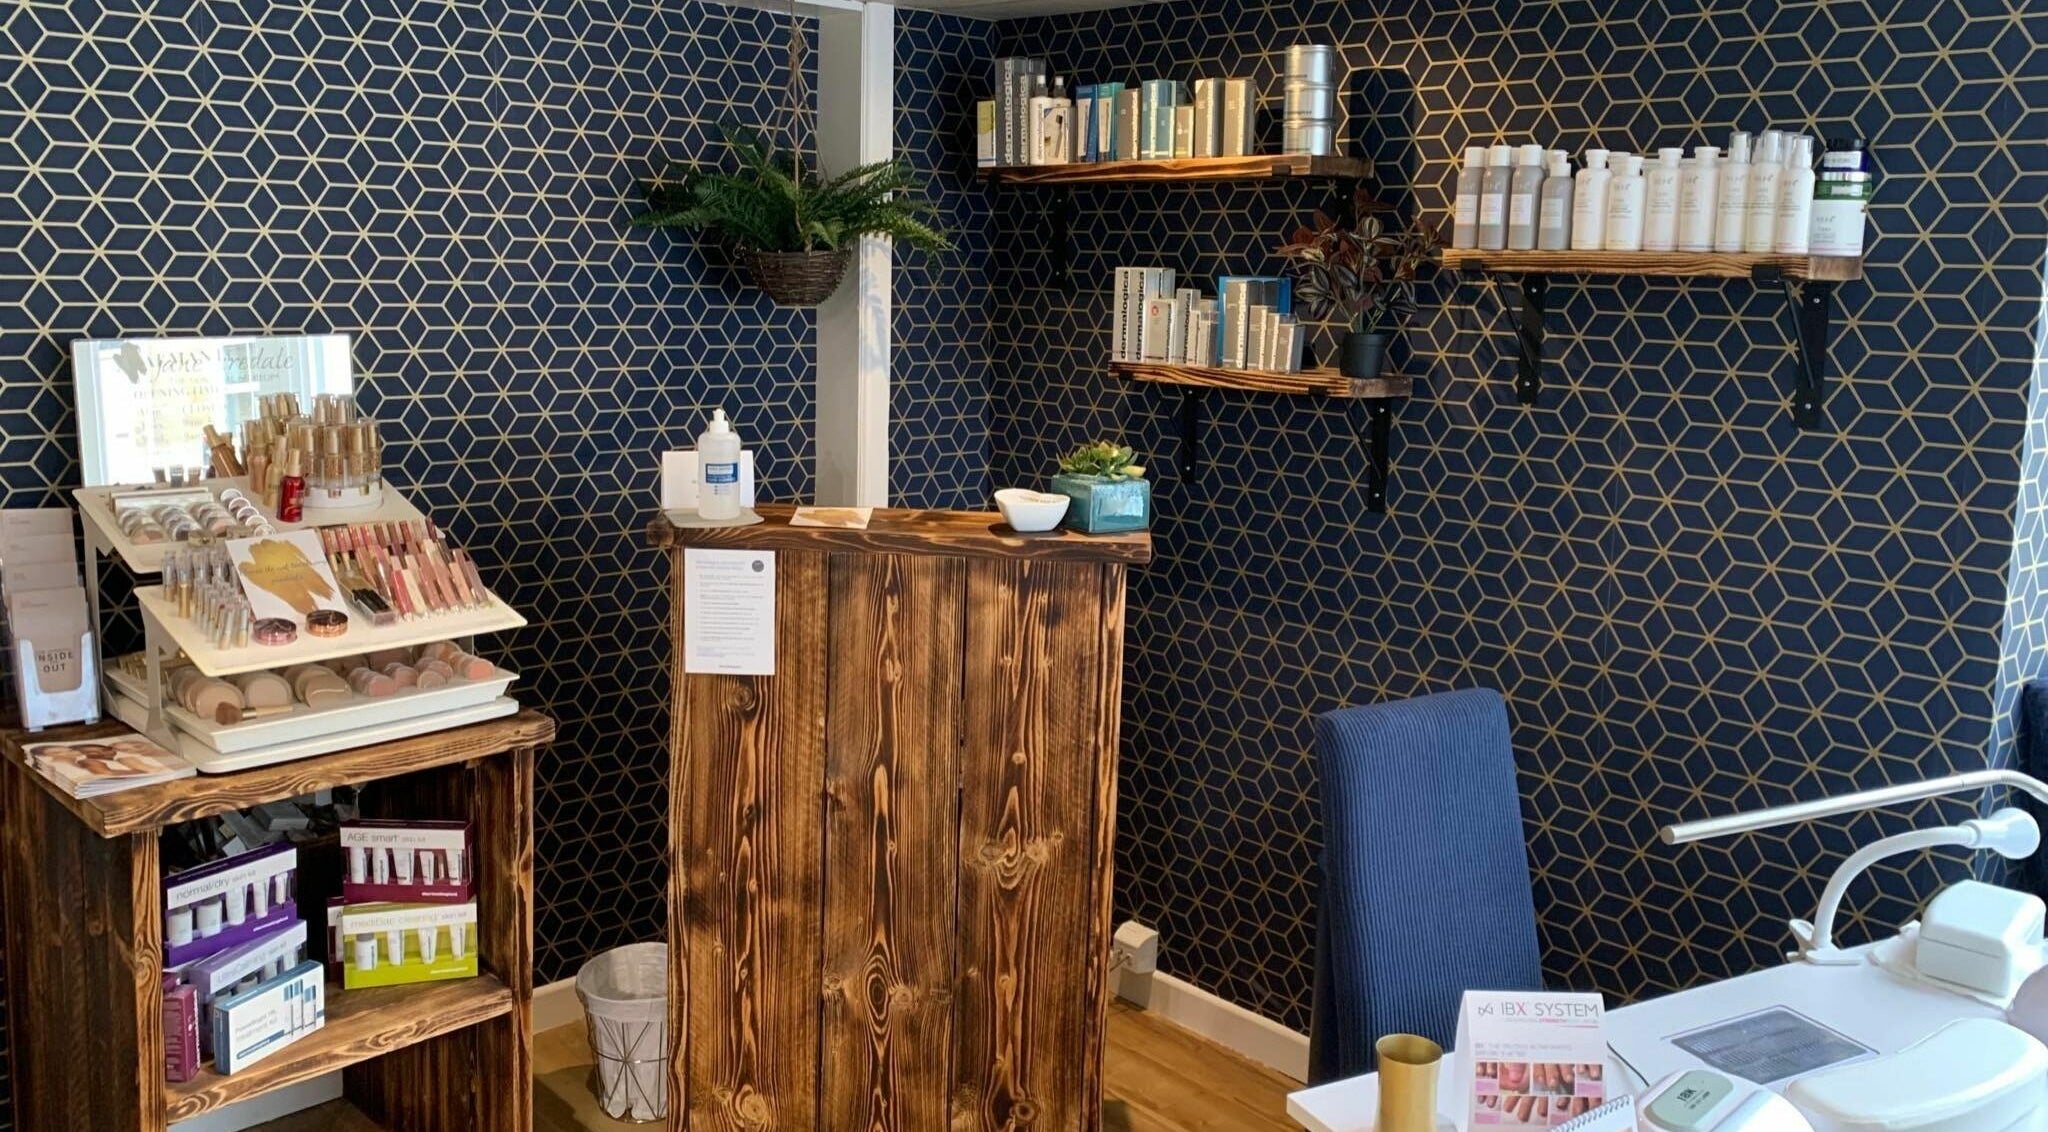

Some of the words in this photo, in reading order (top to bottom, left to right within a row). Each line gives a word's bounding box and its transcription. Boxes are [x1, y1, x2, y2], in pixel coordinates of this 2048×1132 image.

[1004, 59, 1012, 164] dermalogica
[1120, 270, 1129, 359] dermalogica
[1136, 271, 1145, 360] dermalogica
[1236, 283, 1247, 368] dermalogica
[43, 663, 65, 672] OUT
[347, 833, 368, 842] AGE
[371, 833, 397, 842] smart
[176, 877, 229, 900] normal/dry
[1501, 1002, 1527, 1016] IBX
[1534, 1003, 1599, 1018] SYSTEM
